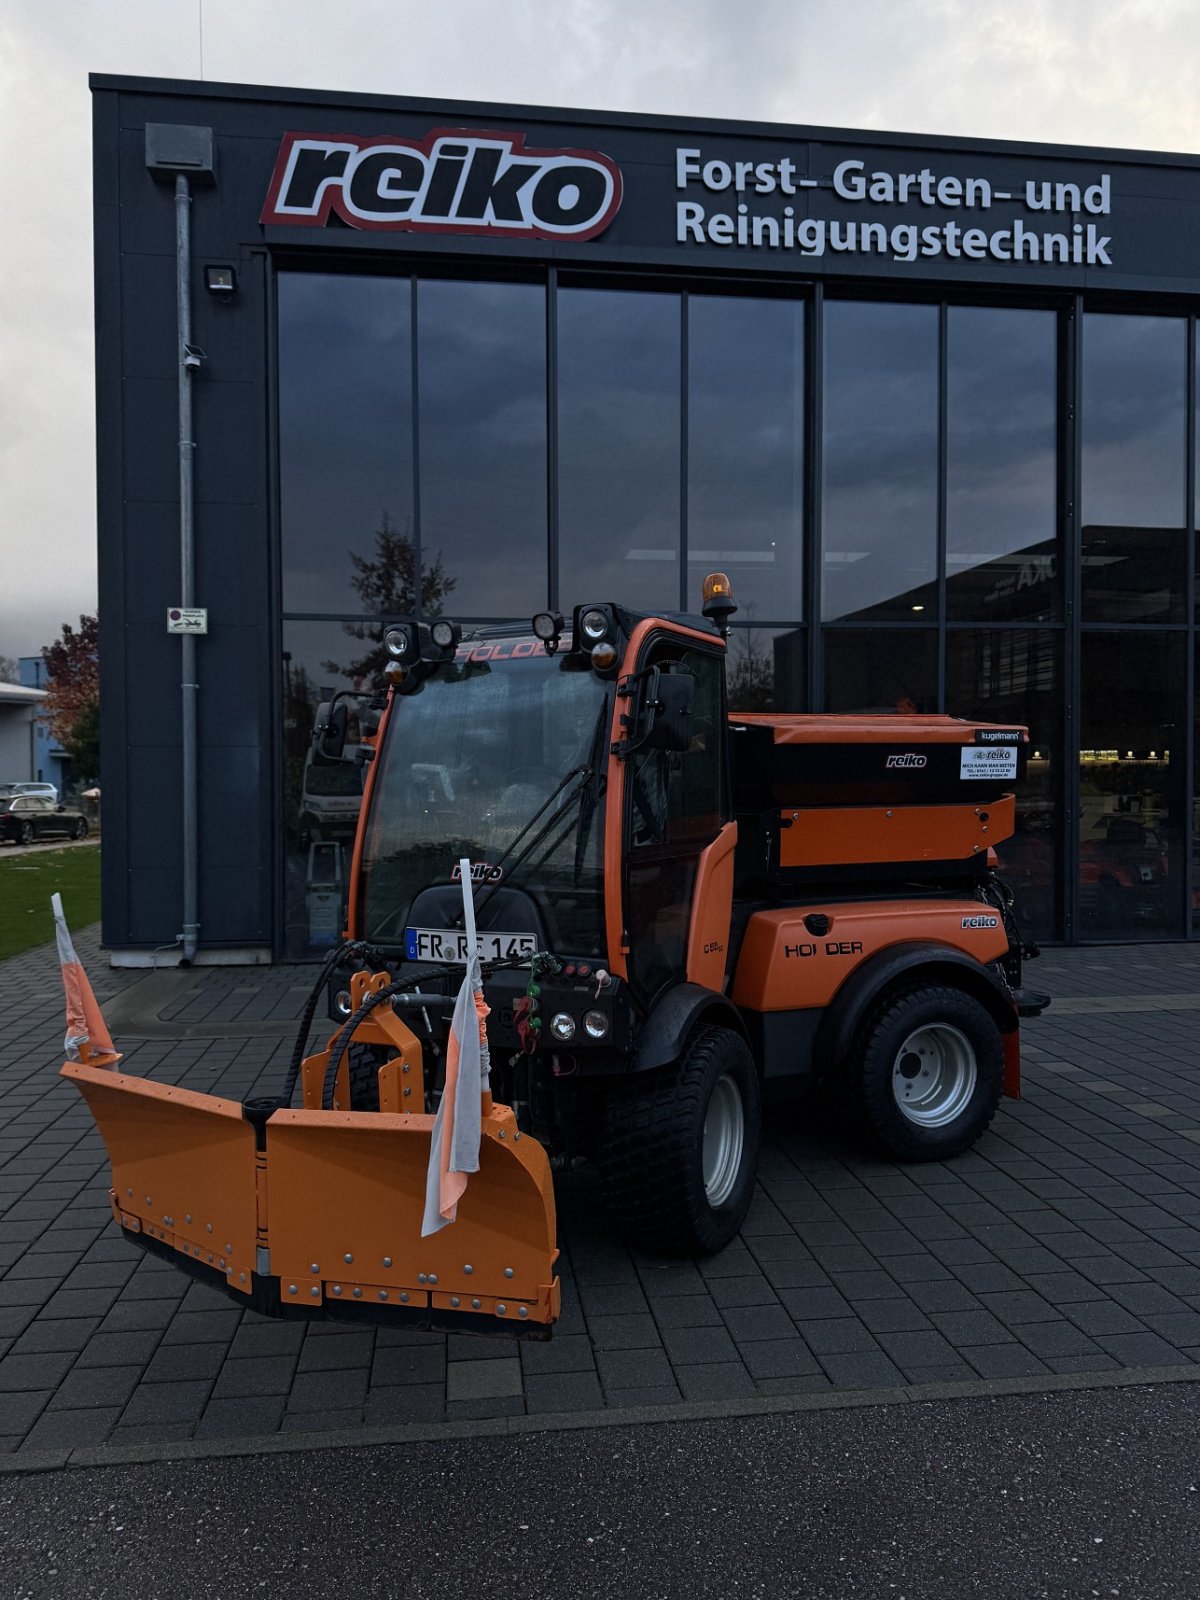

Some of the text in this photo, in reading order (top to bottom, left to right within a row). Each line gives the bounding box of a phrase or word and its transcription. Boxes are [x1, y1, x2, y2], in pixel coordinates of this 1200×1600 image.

[273, 135, 615, 235] reiko
[675, 147, 1113, 215] Forst- Garten- und
[675, 201, 1114, 266] Reinigungstechnik
[885, 752, 928, 768] reiko
[986, 748, 1011, 760] reiko
[961, 915, 999, 929] reiko
[418, 933, 443, 958] FR
